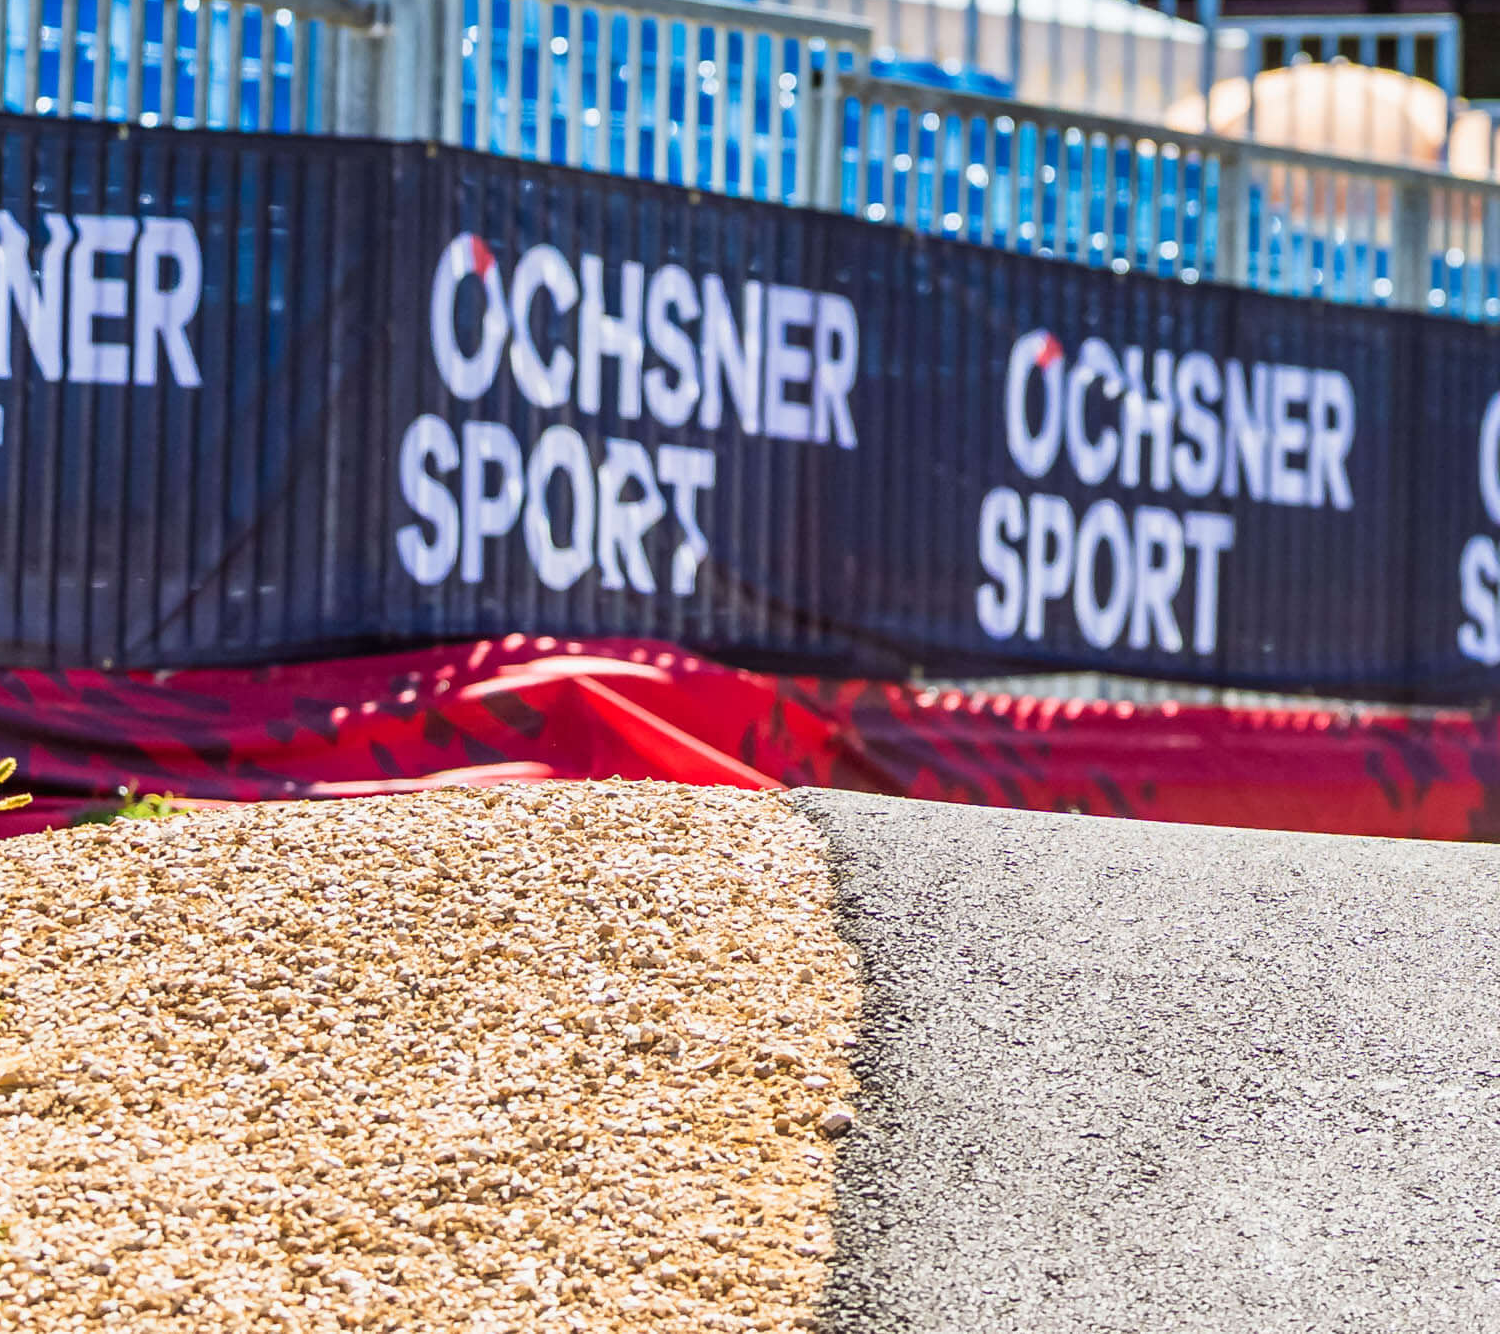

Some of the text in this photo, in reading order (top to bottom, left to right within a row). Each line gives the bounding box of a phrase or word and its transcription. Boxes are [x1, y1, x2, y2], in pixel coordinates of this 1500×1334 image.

[431, 230, 860, 451] OCHSNER
[1005, 330, 1356, 511] OCHSNER
[396, 415, 715, 597] SPORT
[976, 487, 1235, 655] SPORT
